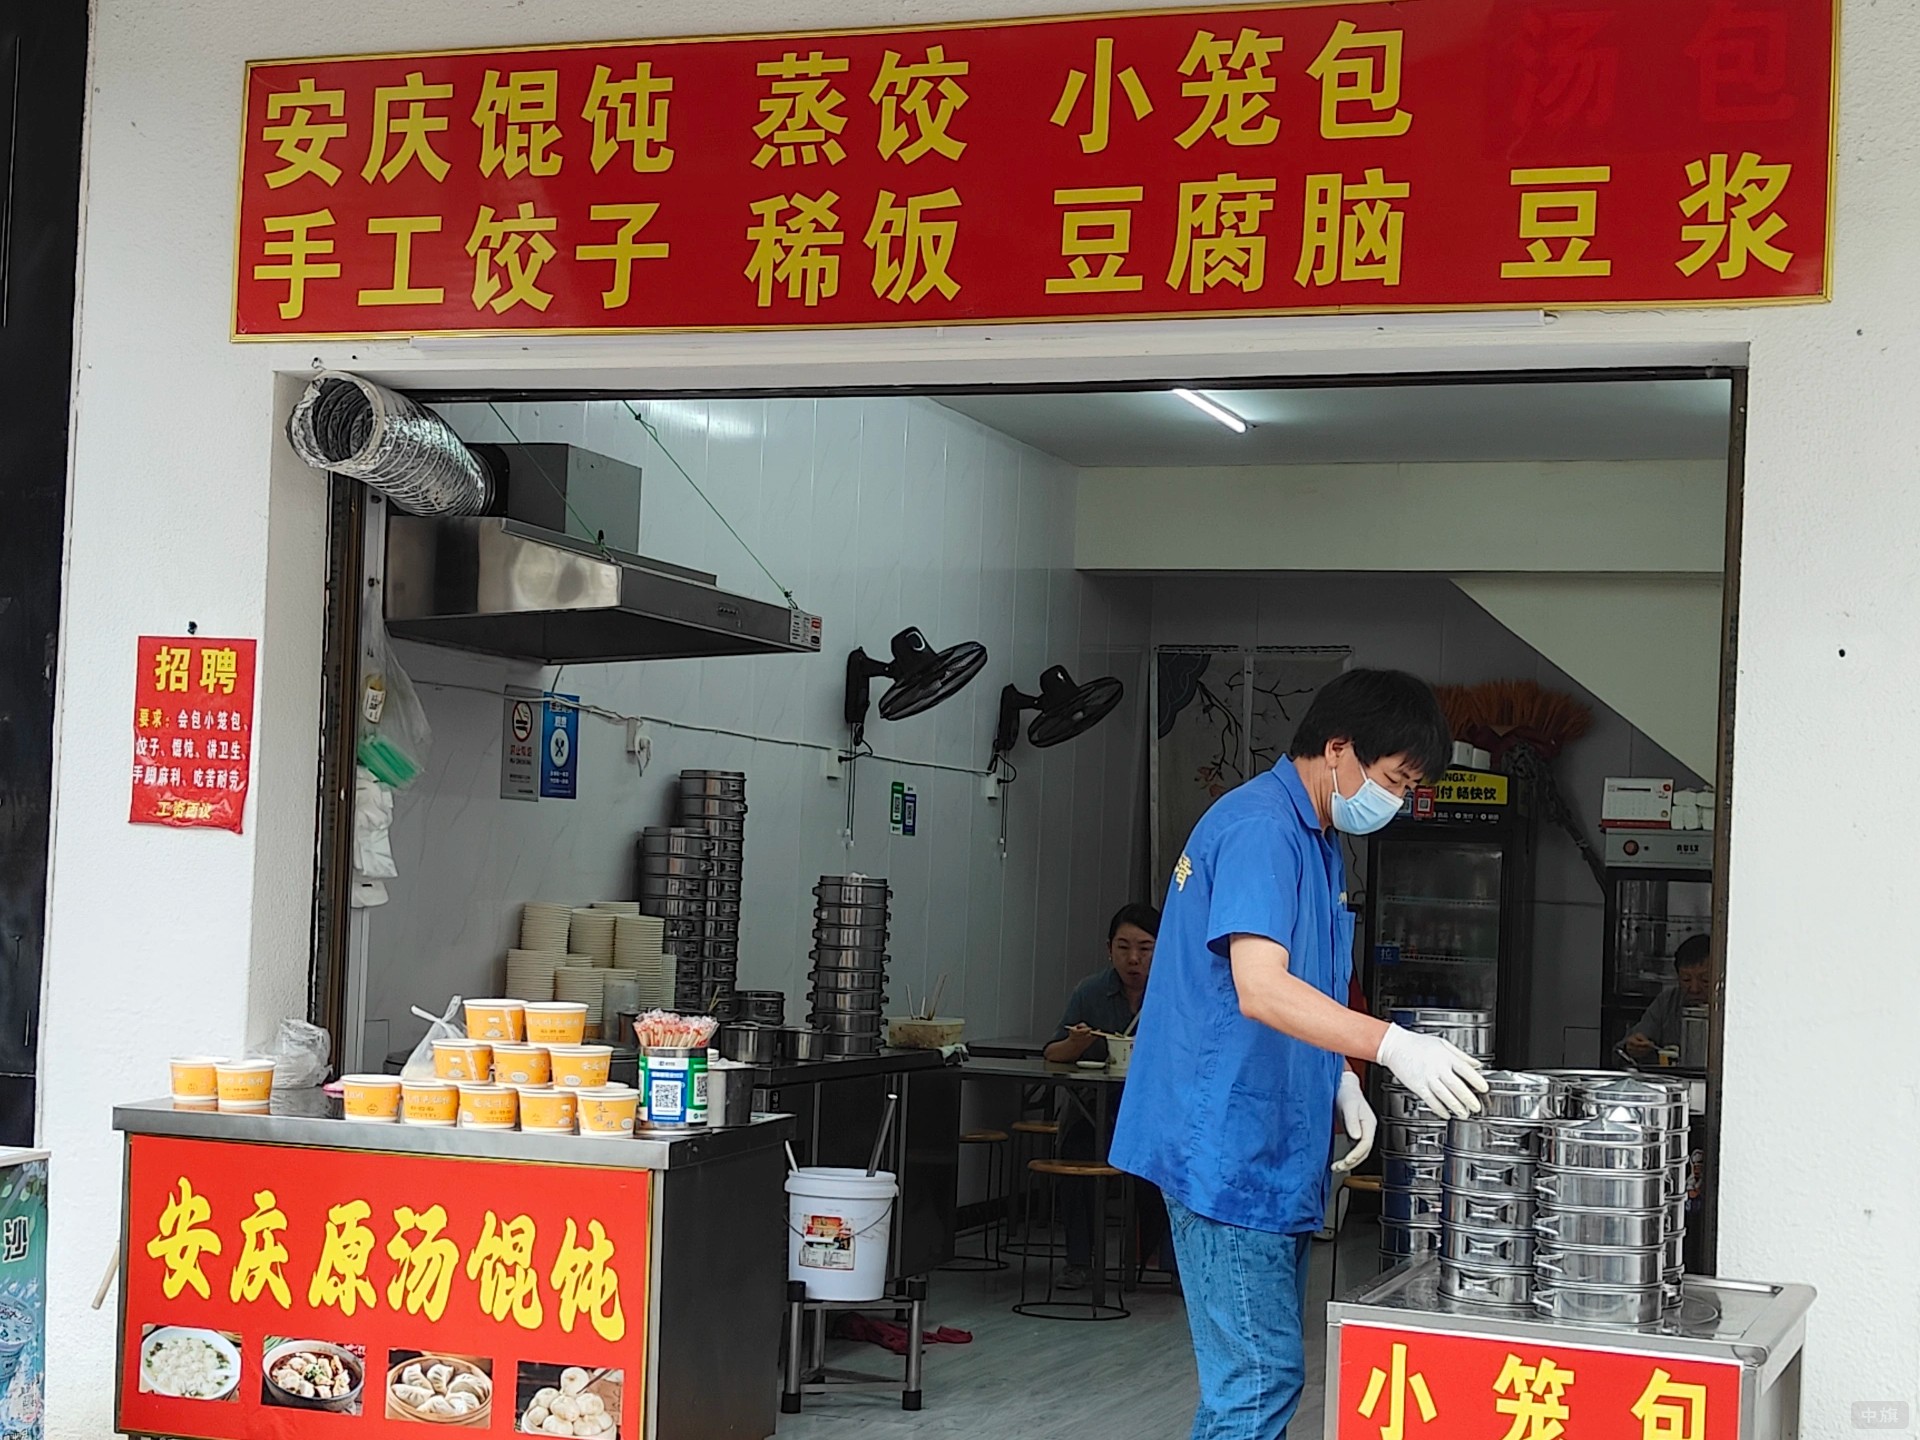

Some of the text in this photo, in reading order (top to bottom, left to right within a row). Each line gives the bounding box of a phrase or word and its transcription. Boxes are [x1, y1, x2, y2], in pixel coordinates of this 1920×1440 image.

[262, 62, 675, 190] 安庆馄饨
[751, 45, 969, 168] 蒸饺
[1050, 20, 1413, 154] 小笼包
[253, 151, 1795, 320] 手工饺子 稀饭 豆腐脑 豆浆
[155, 645, 238, 694] 招聘
[145, 1175, 626, 1344] 安庆原汤馄饨
